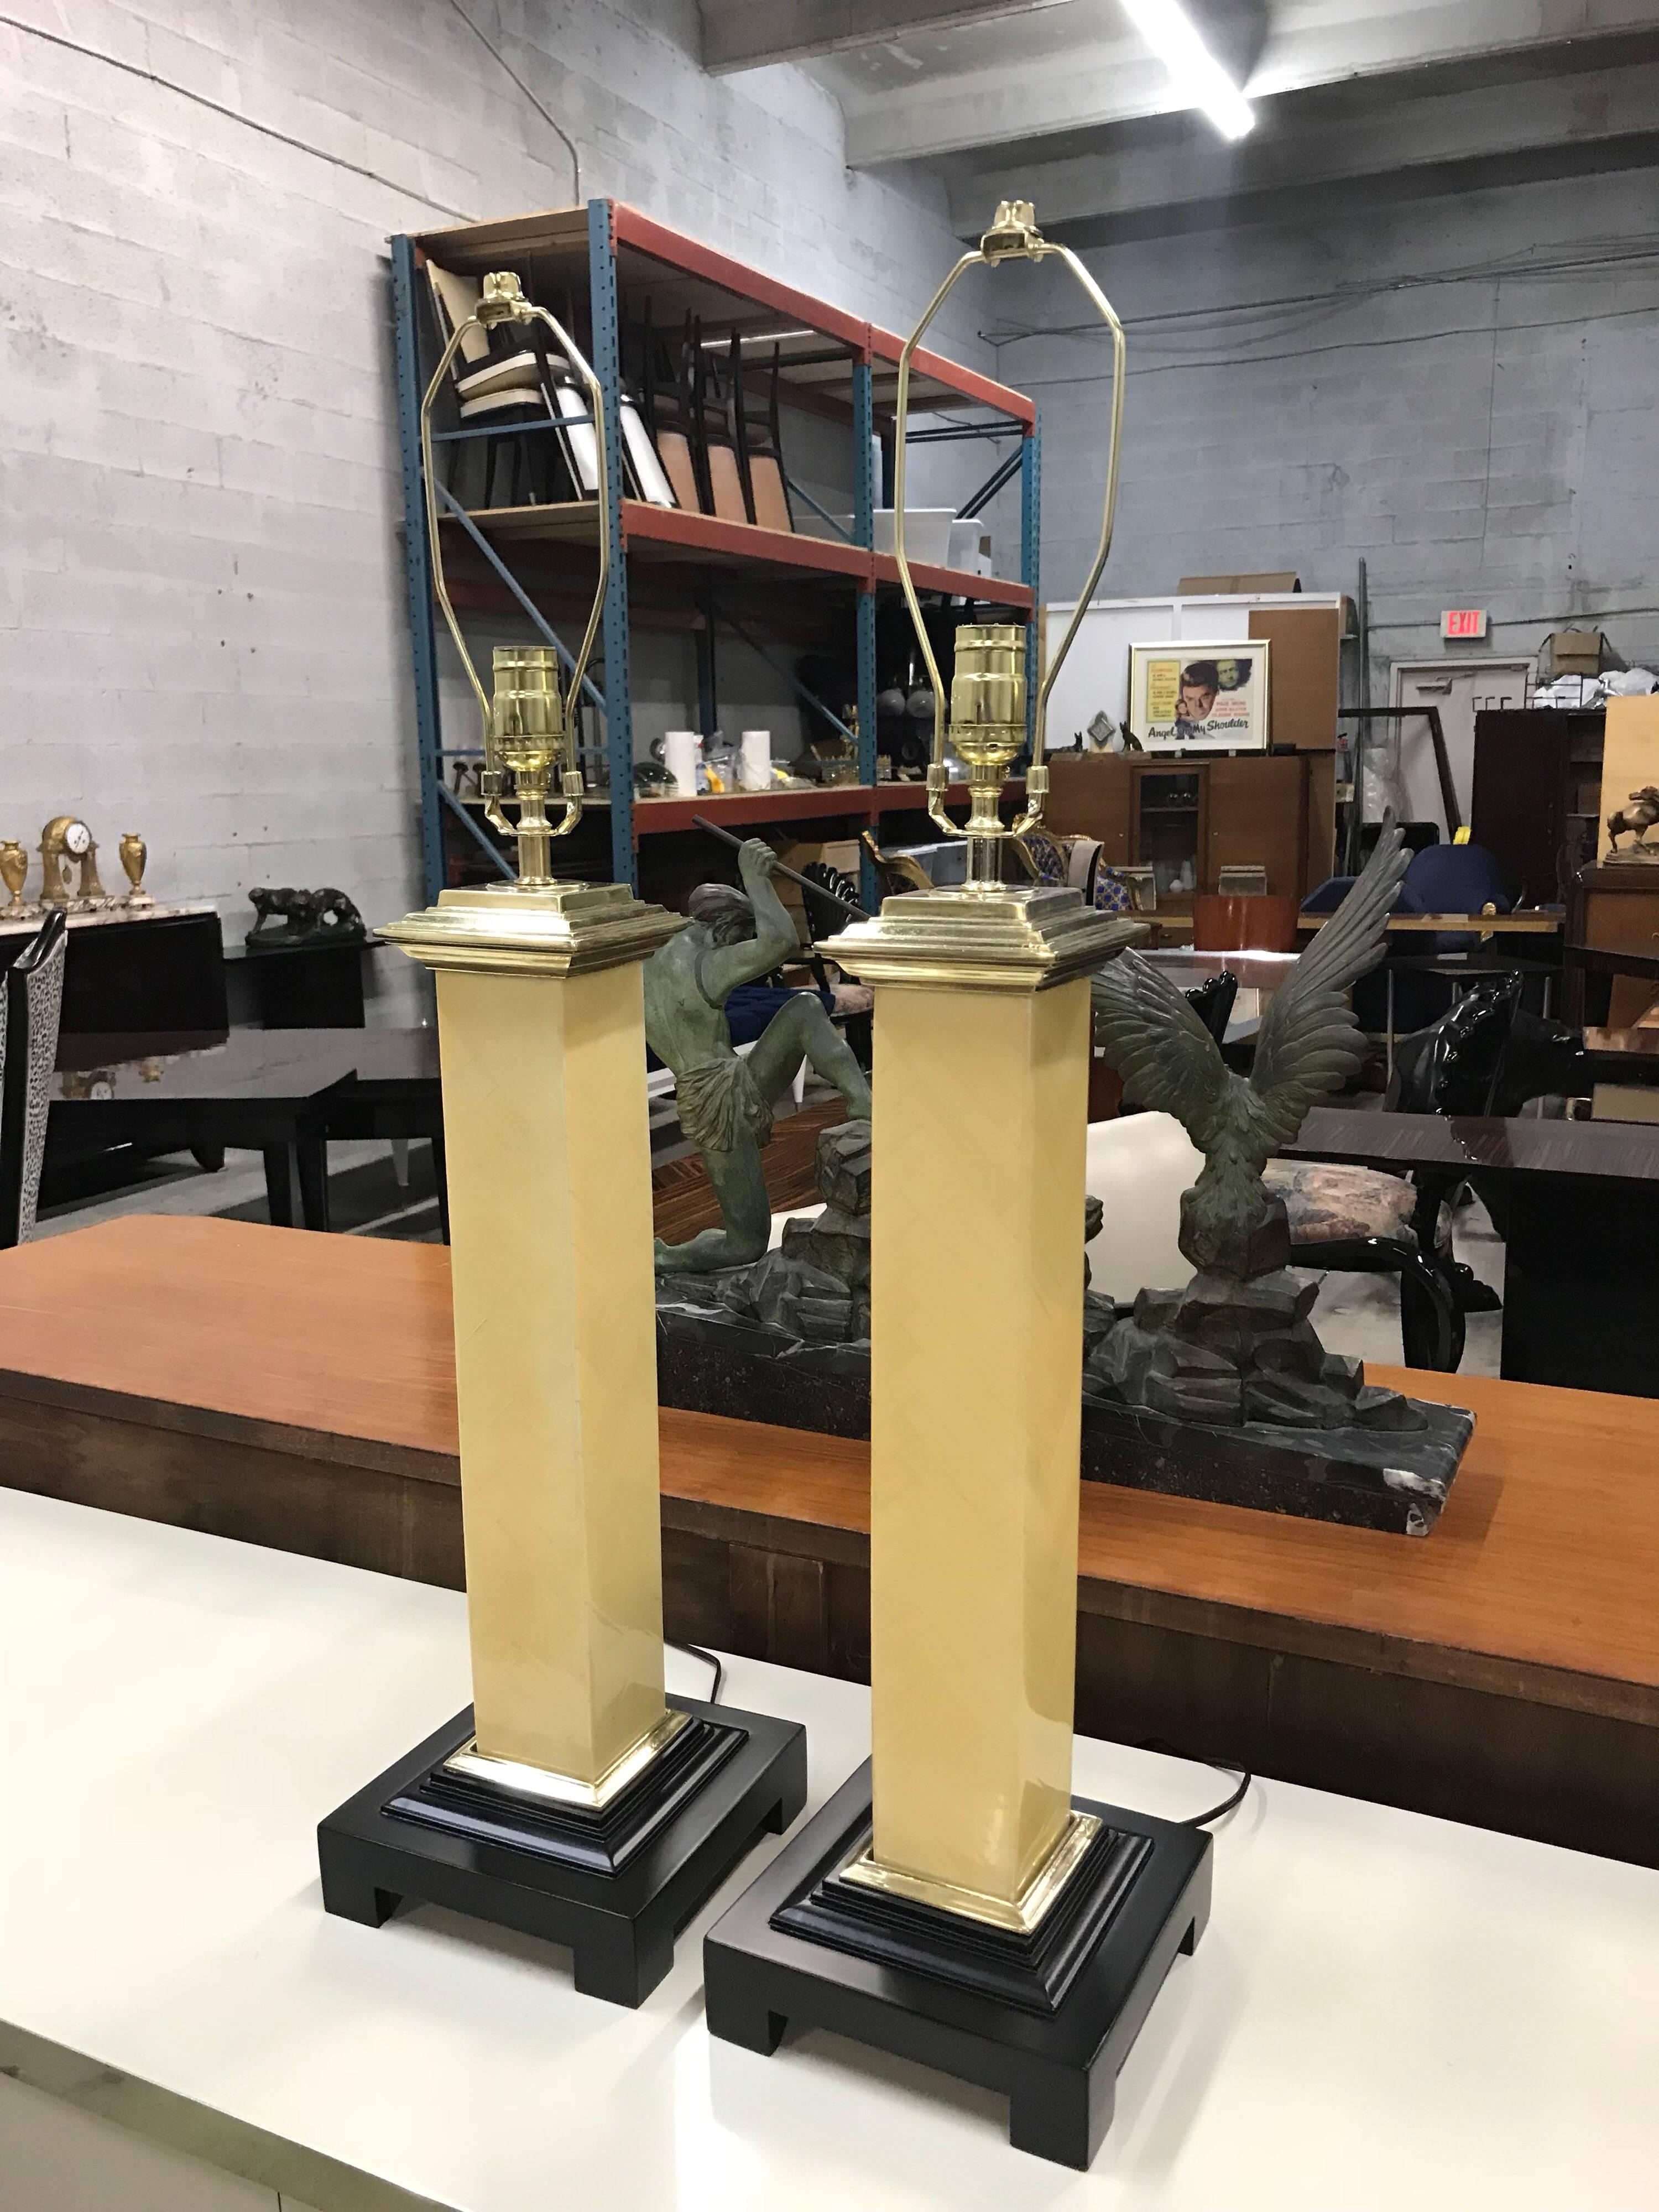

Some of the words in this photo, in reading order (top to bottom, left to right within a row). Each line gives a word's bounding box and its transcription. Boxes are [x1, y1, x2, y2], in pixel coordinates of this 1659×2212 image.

[1448, 611, 1480, 635] EXIT
[1148, 727, 1176, 740] Angel
[1192, 723, 1206, 734] My
[1207, 718, 1249, 731] Shoulder
